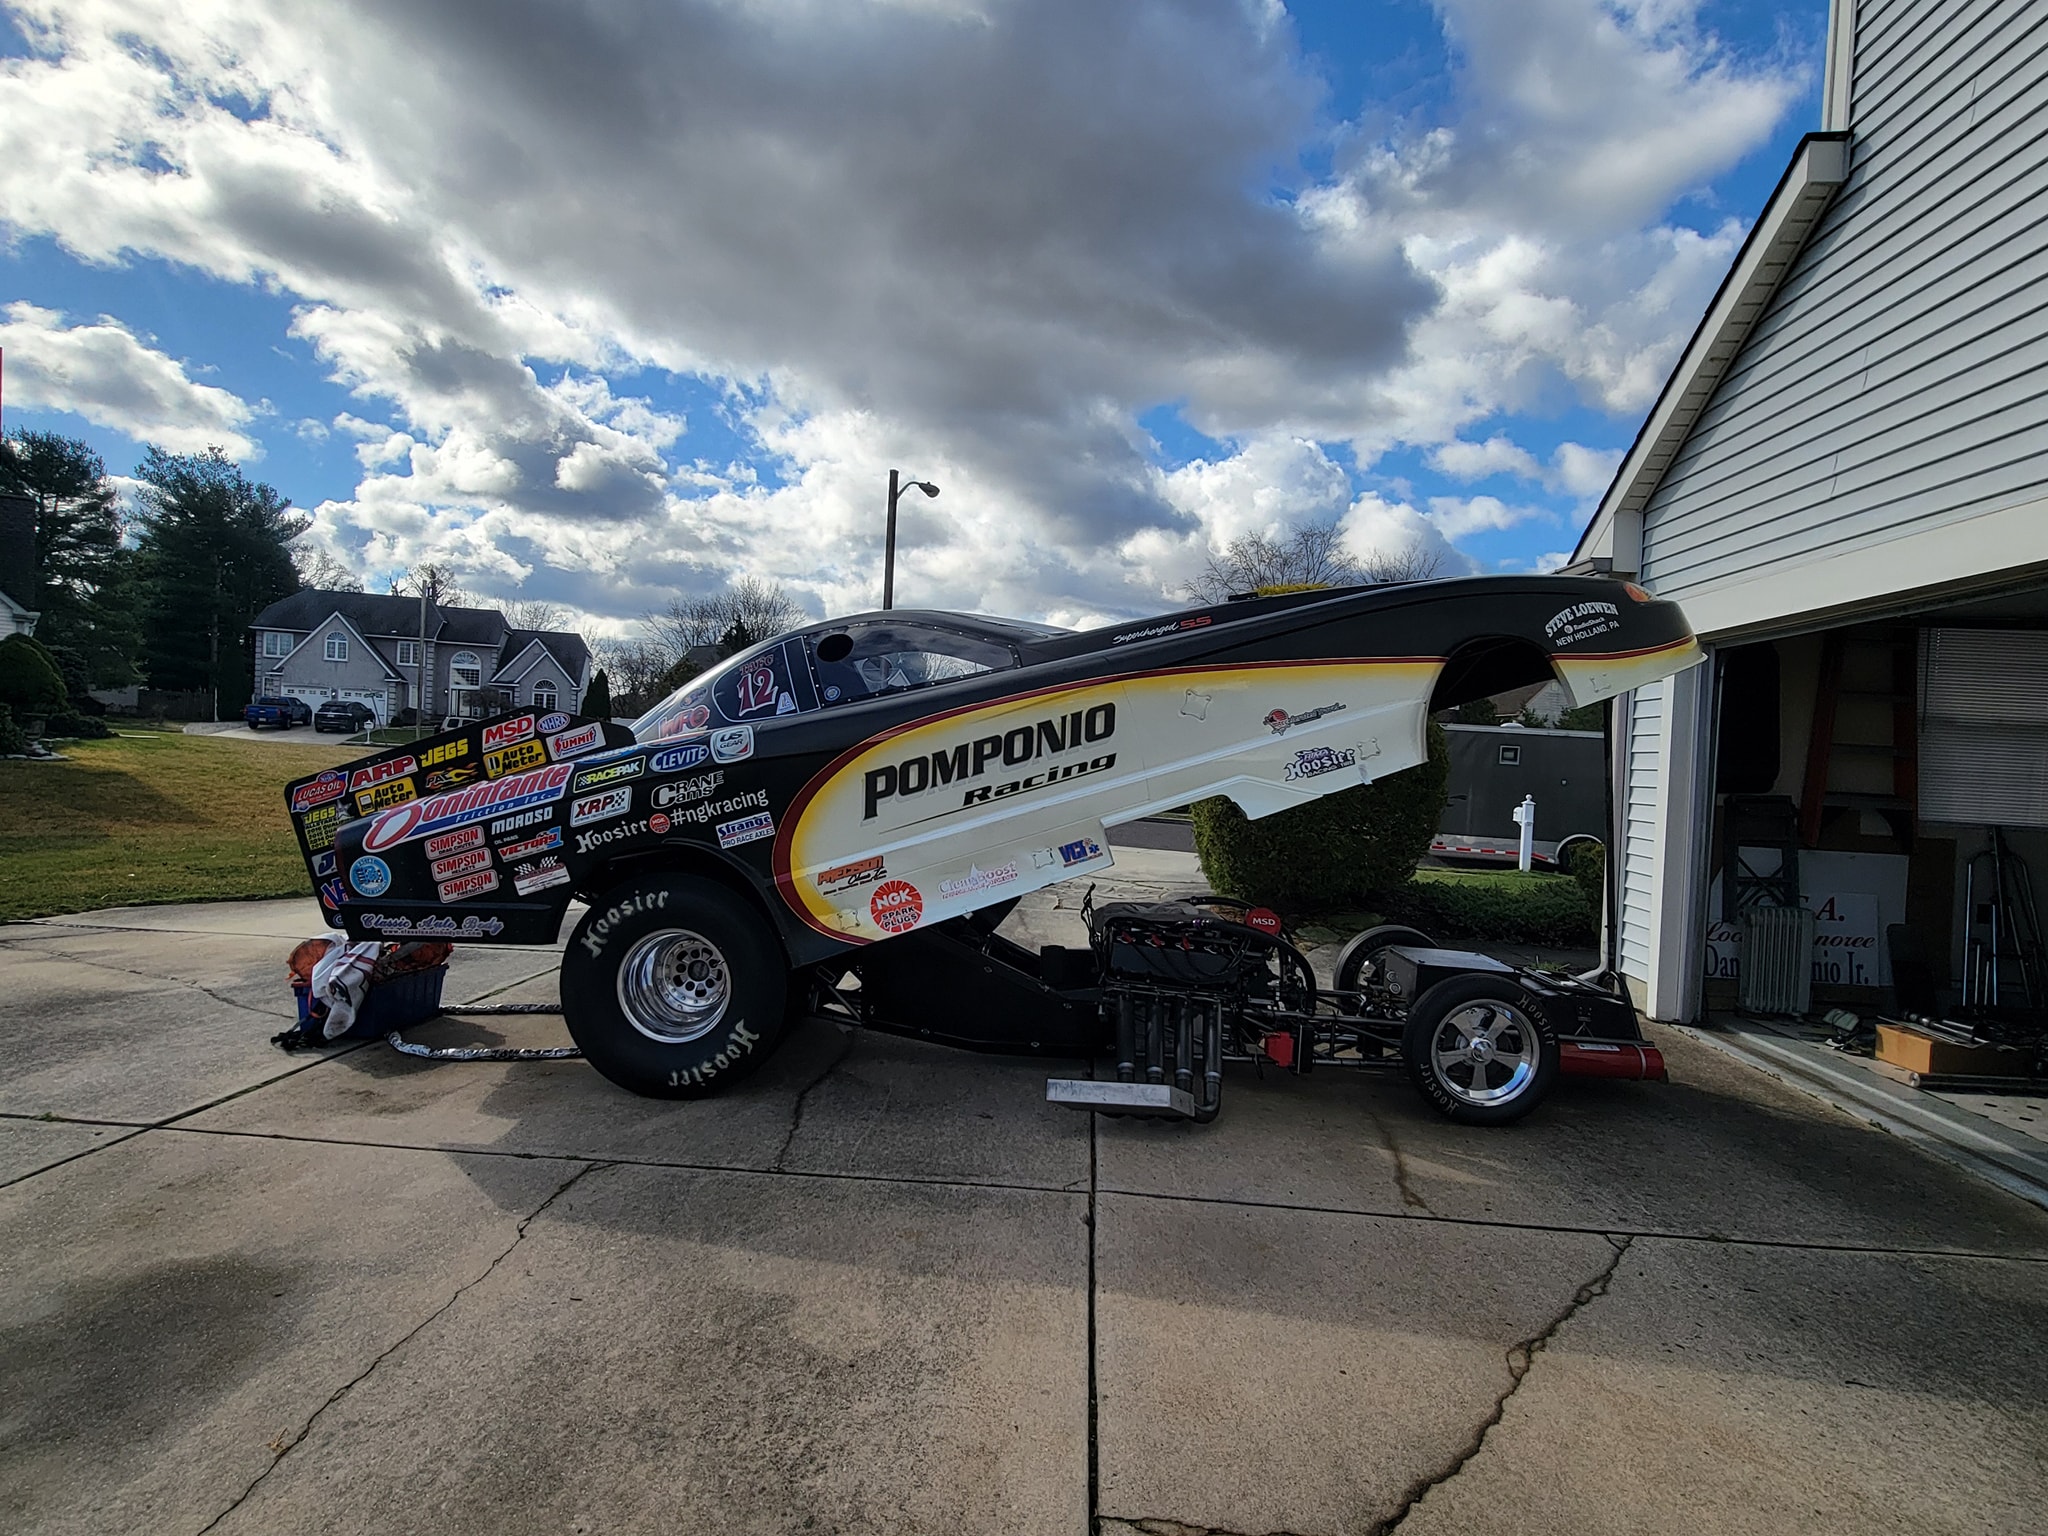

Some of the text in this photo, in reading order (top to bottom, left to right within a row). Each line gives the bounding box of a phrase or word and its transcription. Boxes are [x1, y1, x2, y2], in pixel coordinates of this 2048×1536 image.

[1112, 616, 1212, 645] Supercharged SS
[1545, 601, 1619, 638] STEVE LOEWEN
[1555, 620, 1620, 647] NEW HOLLAND, PA
[736, 667, 780, 718] 12
[485, 717, 532, 744] MSD
[540, 715, 567, 730] NHRA
[719, 739, 744, 748] GEAR
[721, 731, 742, 741] US
[421, 738, 469, 768] JEGS
[501, 753, 543, 774] Meter
[503, 745, 534, 760] Auto
[650, 746, 707, 772] CLEVITE
[860, 702, 1116, 826] POMPONIO
[351, 757, 413, 788] ARP
[588, 761, 640, 783] RACEPAK
[1284, 749, 1355, 781] Hoosier
[298, 784, 326, 801] LUCAS
[327, 781, 341, 792] OIL
[374, 783, 405, 800] Auto
[651, 770, 724, 809] CRANE
[963, 753, 1117, 806] Racing
[374, 790, 413, 811] Meter
[455, 794, 552, 823] Friction Inc.
[575, 795, 615, 819] XRP
[670, 789, 769, 826] #ngkracing
[304, 806, 336, 825] JEGS
[491, 807, 553, 835] MOROSO
[718, 815, 771, 838] Strange
[430, 829, 478, 853] SIMPSON
[576, 819, 647, 853] Hoosier
[722, 828, 774, 847] PRO RACE AXLES
[436, 851, 485, 875] SIMPSON
[443, 873, 492, 897] SIMPSON
[876, 888, 912, 910] NGK
[580, 889, 669, 959] Hoosier
[882, 905, 915, 920] SPARK
[884, 913, 917, 929] PLUGS
[1252, 917, 1276, 926] MSD
[360, 914, 411, 929] Classic
[417, 915, 457, 930] Auto
[462, 916, 504, 936] Body
[668, 1018, 760, 1087] Hoosier
